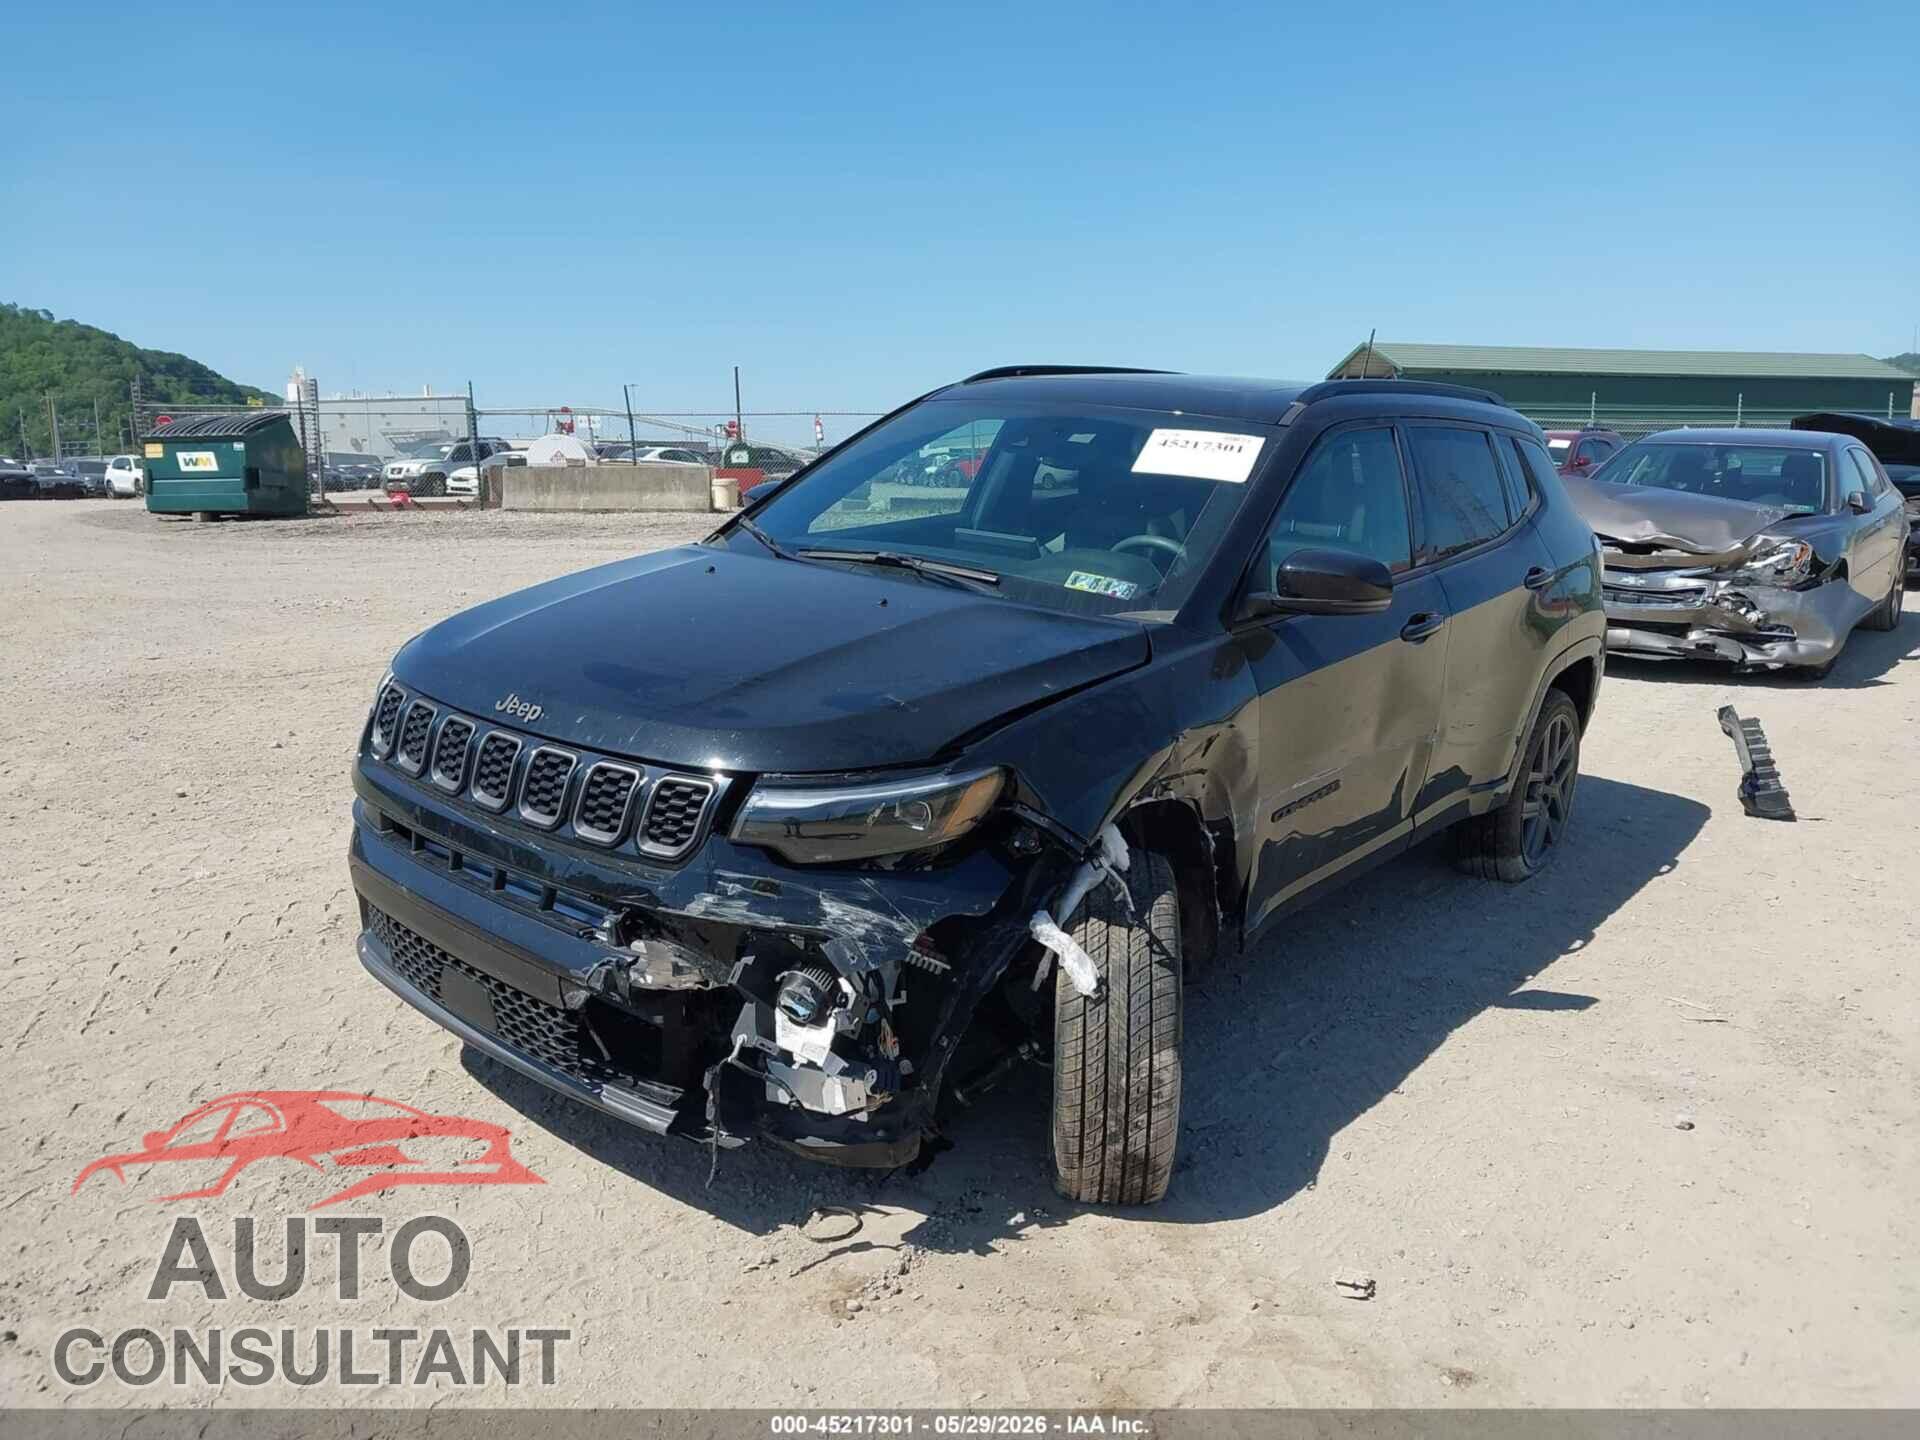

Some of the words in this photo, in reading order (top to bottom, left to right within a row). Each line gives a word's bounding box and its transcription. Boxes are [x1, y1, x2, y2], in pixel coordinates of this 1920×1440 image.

[1158, 439, 1243, 453] 45217301
[183, 456, 213, 468] WM
[495, 693, 542, 723] Jeep
